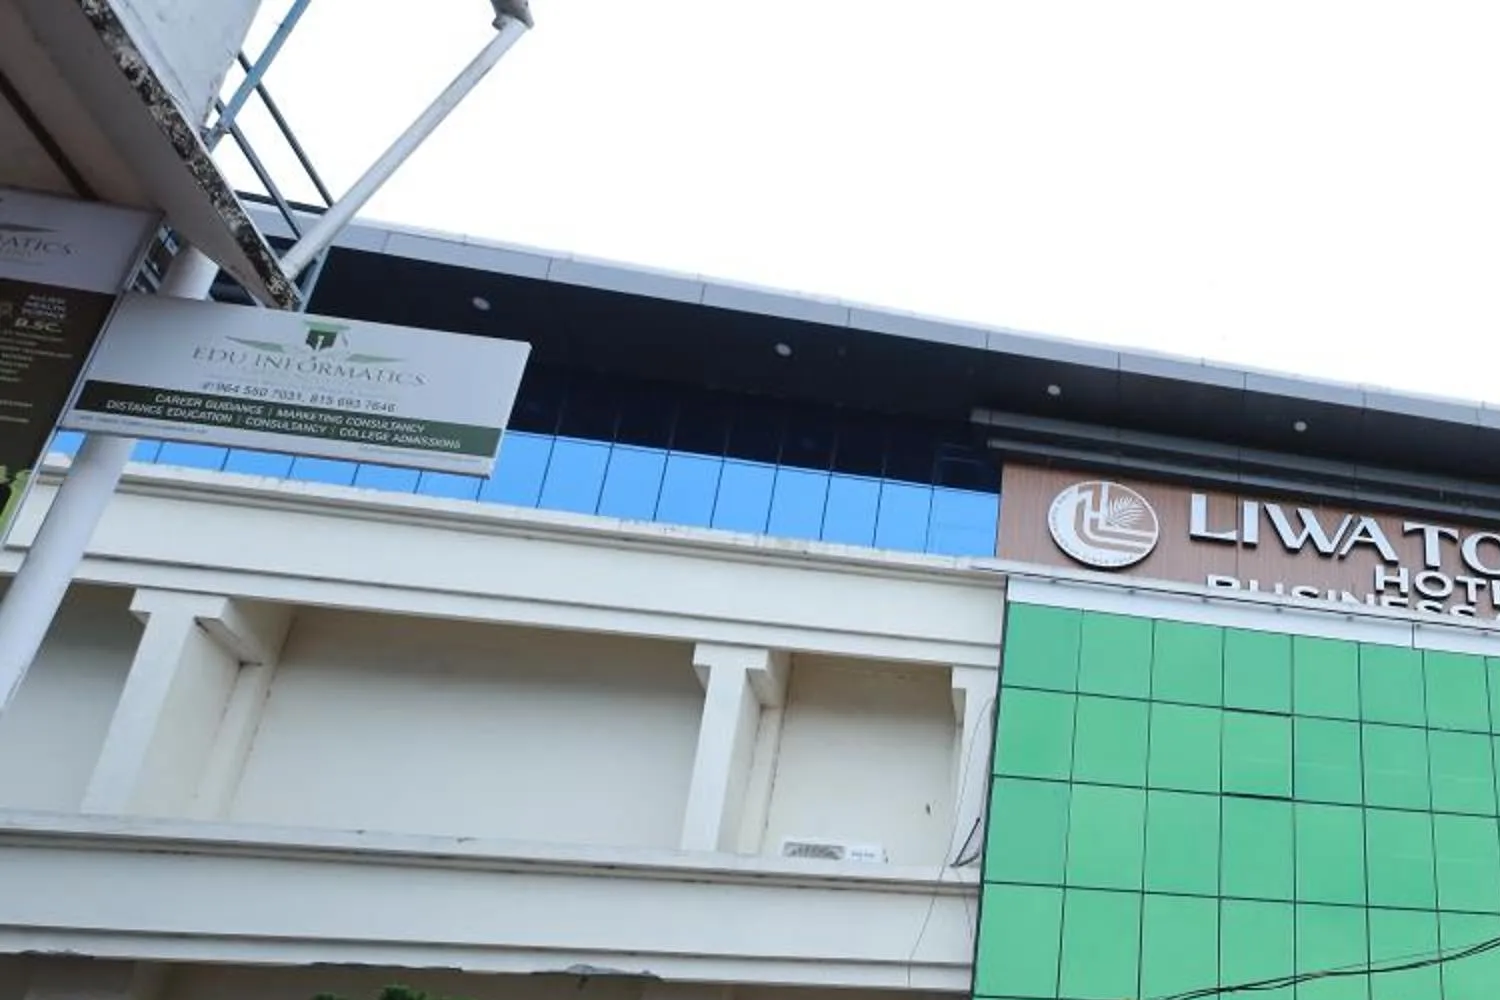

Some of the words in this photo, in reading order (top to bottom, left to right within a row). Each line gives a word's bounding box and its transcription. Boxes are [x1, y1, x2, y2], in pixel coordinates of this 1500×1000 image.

[106, 399, 163, 416] DISTANCE
[167, 408, 233, 424] EDUCATION
[245, 416, 328, 434] CONSULTANCY
[339, 426, 389, 442] COLLEGE
[155, 393, 202, 408] CAREER
[205, 399, 264, 415] GUIDANCE
[276, 408, 344, 425] MARKETING
[345, 416, 426, 433] CONSULTANCY
